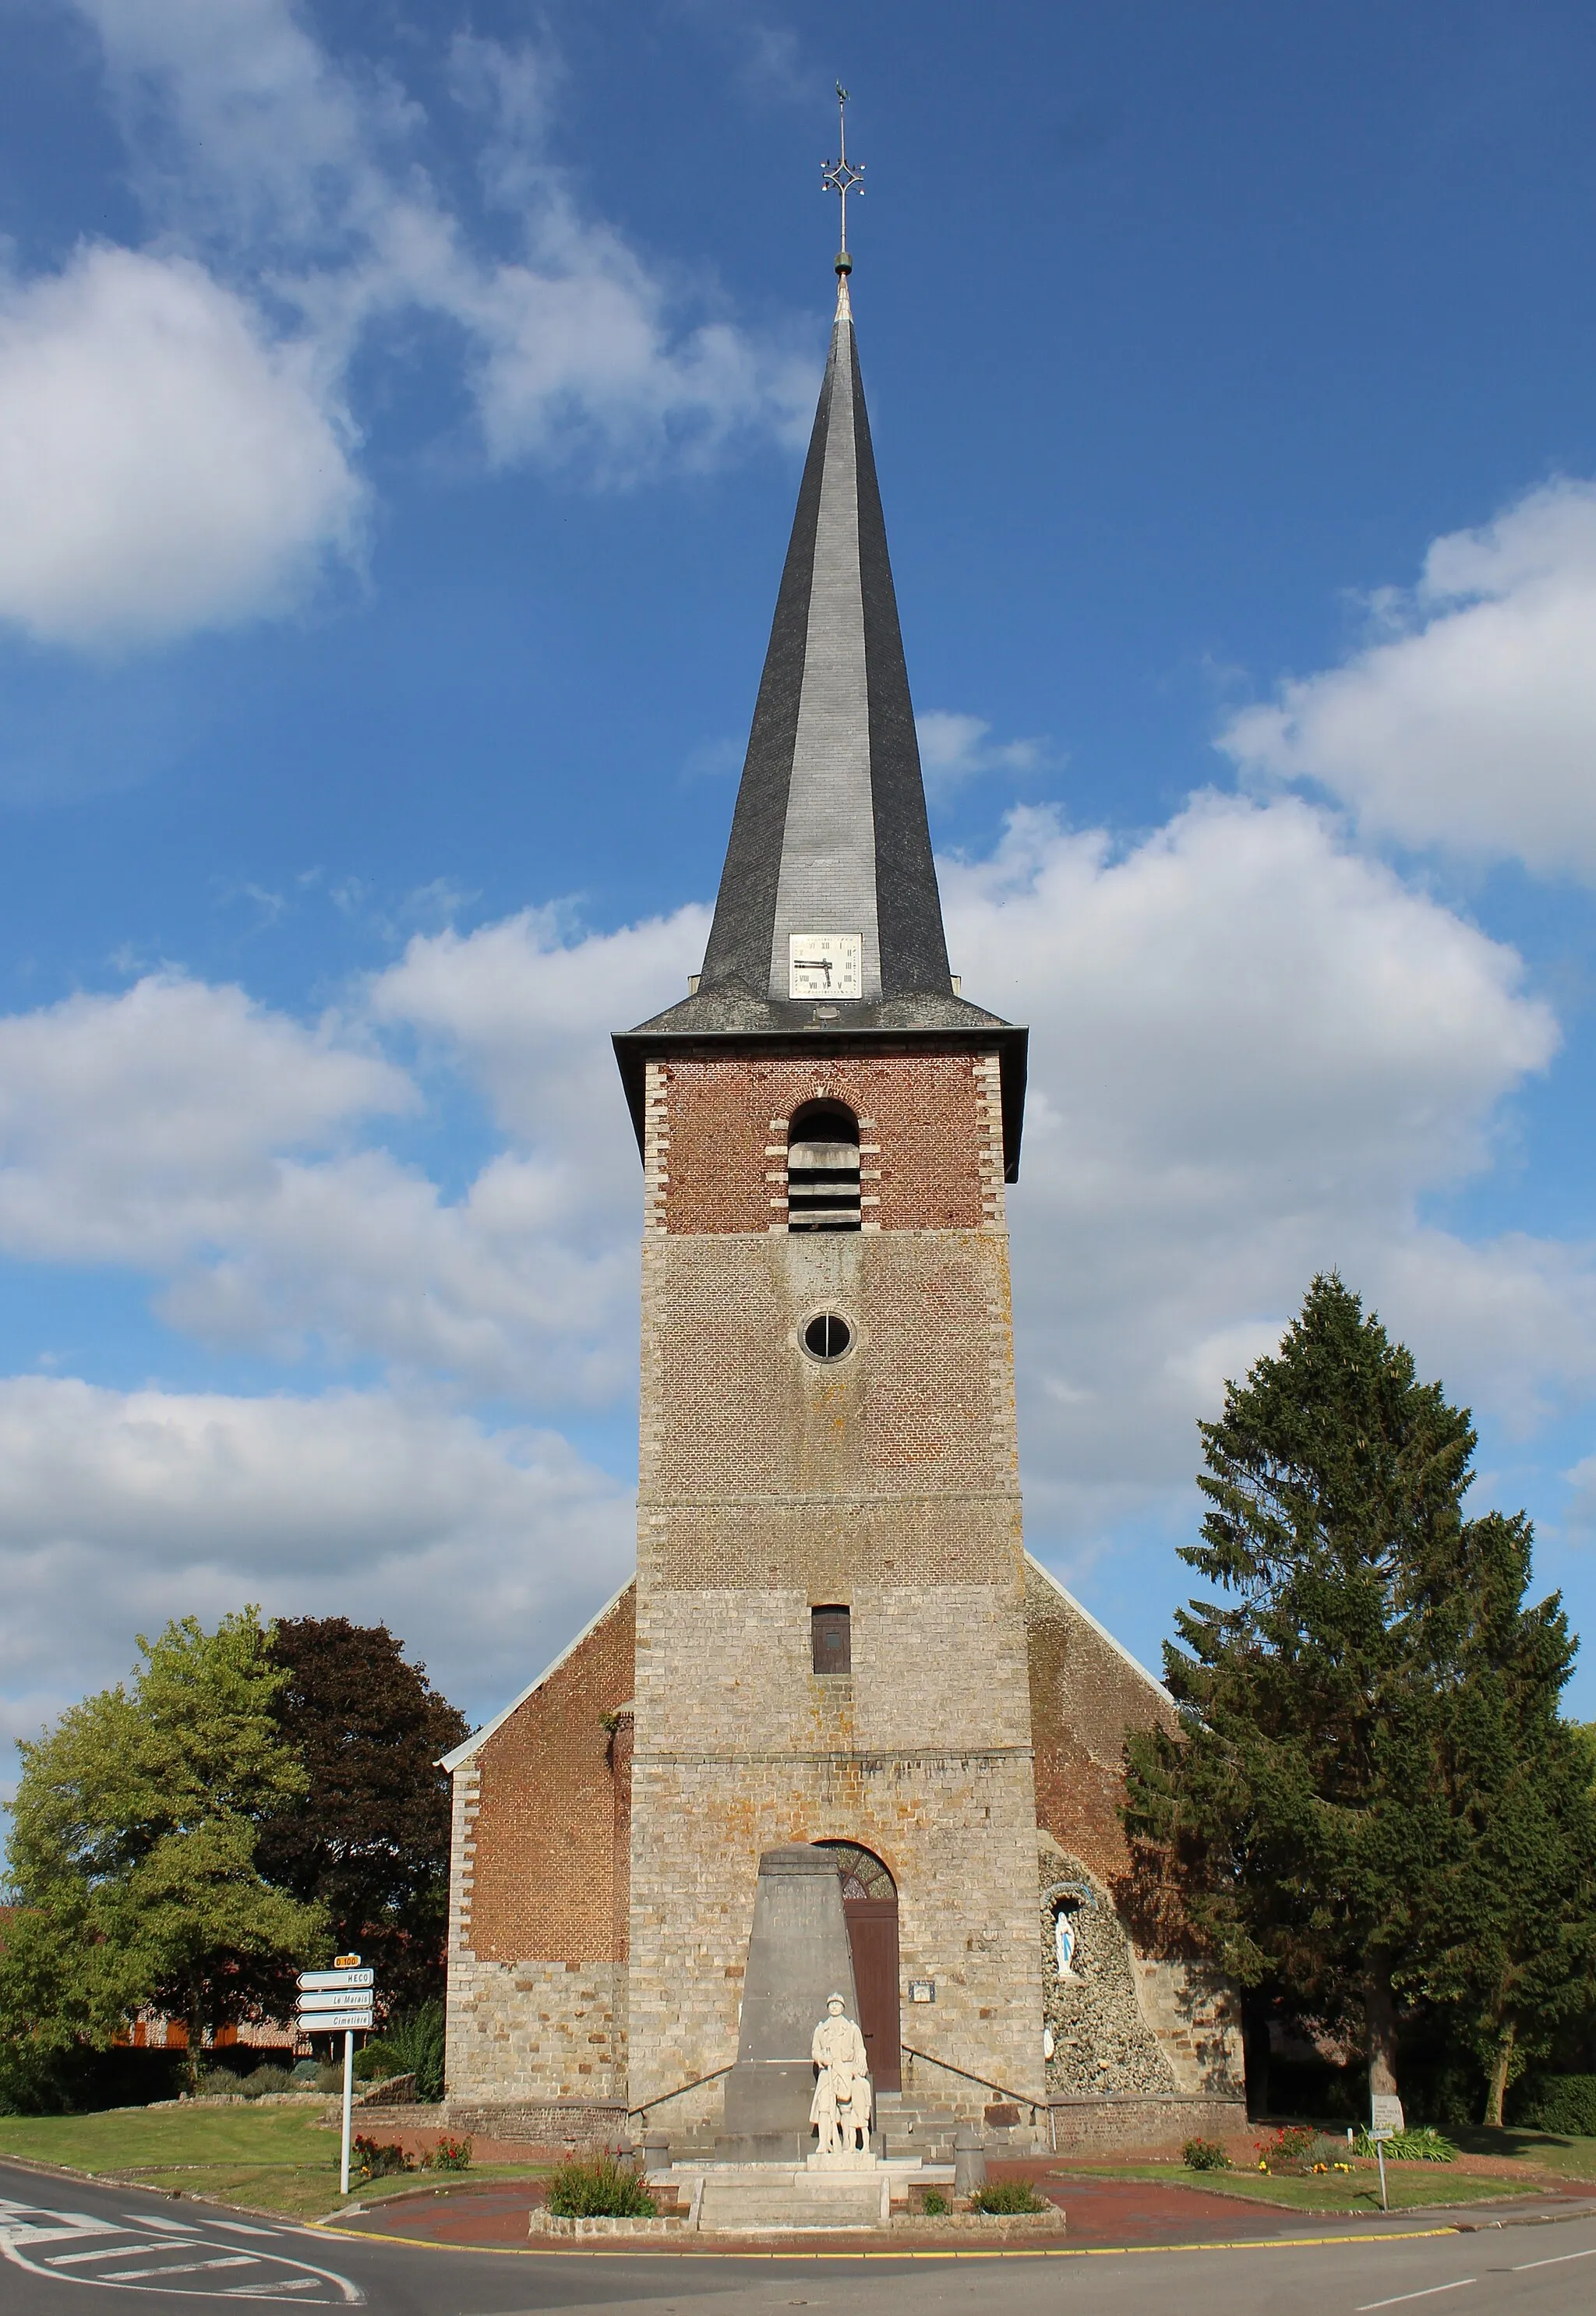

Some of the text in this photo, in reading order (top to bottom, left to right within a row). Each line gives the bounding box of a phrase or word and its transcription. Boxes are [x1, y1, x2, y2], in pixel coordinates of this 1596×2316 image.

[344, 1958, 356, 1966] 100
[333, 1994, 368, 2004] Le Marais
